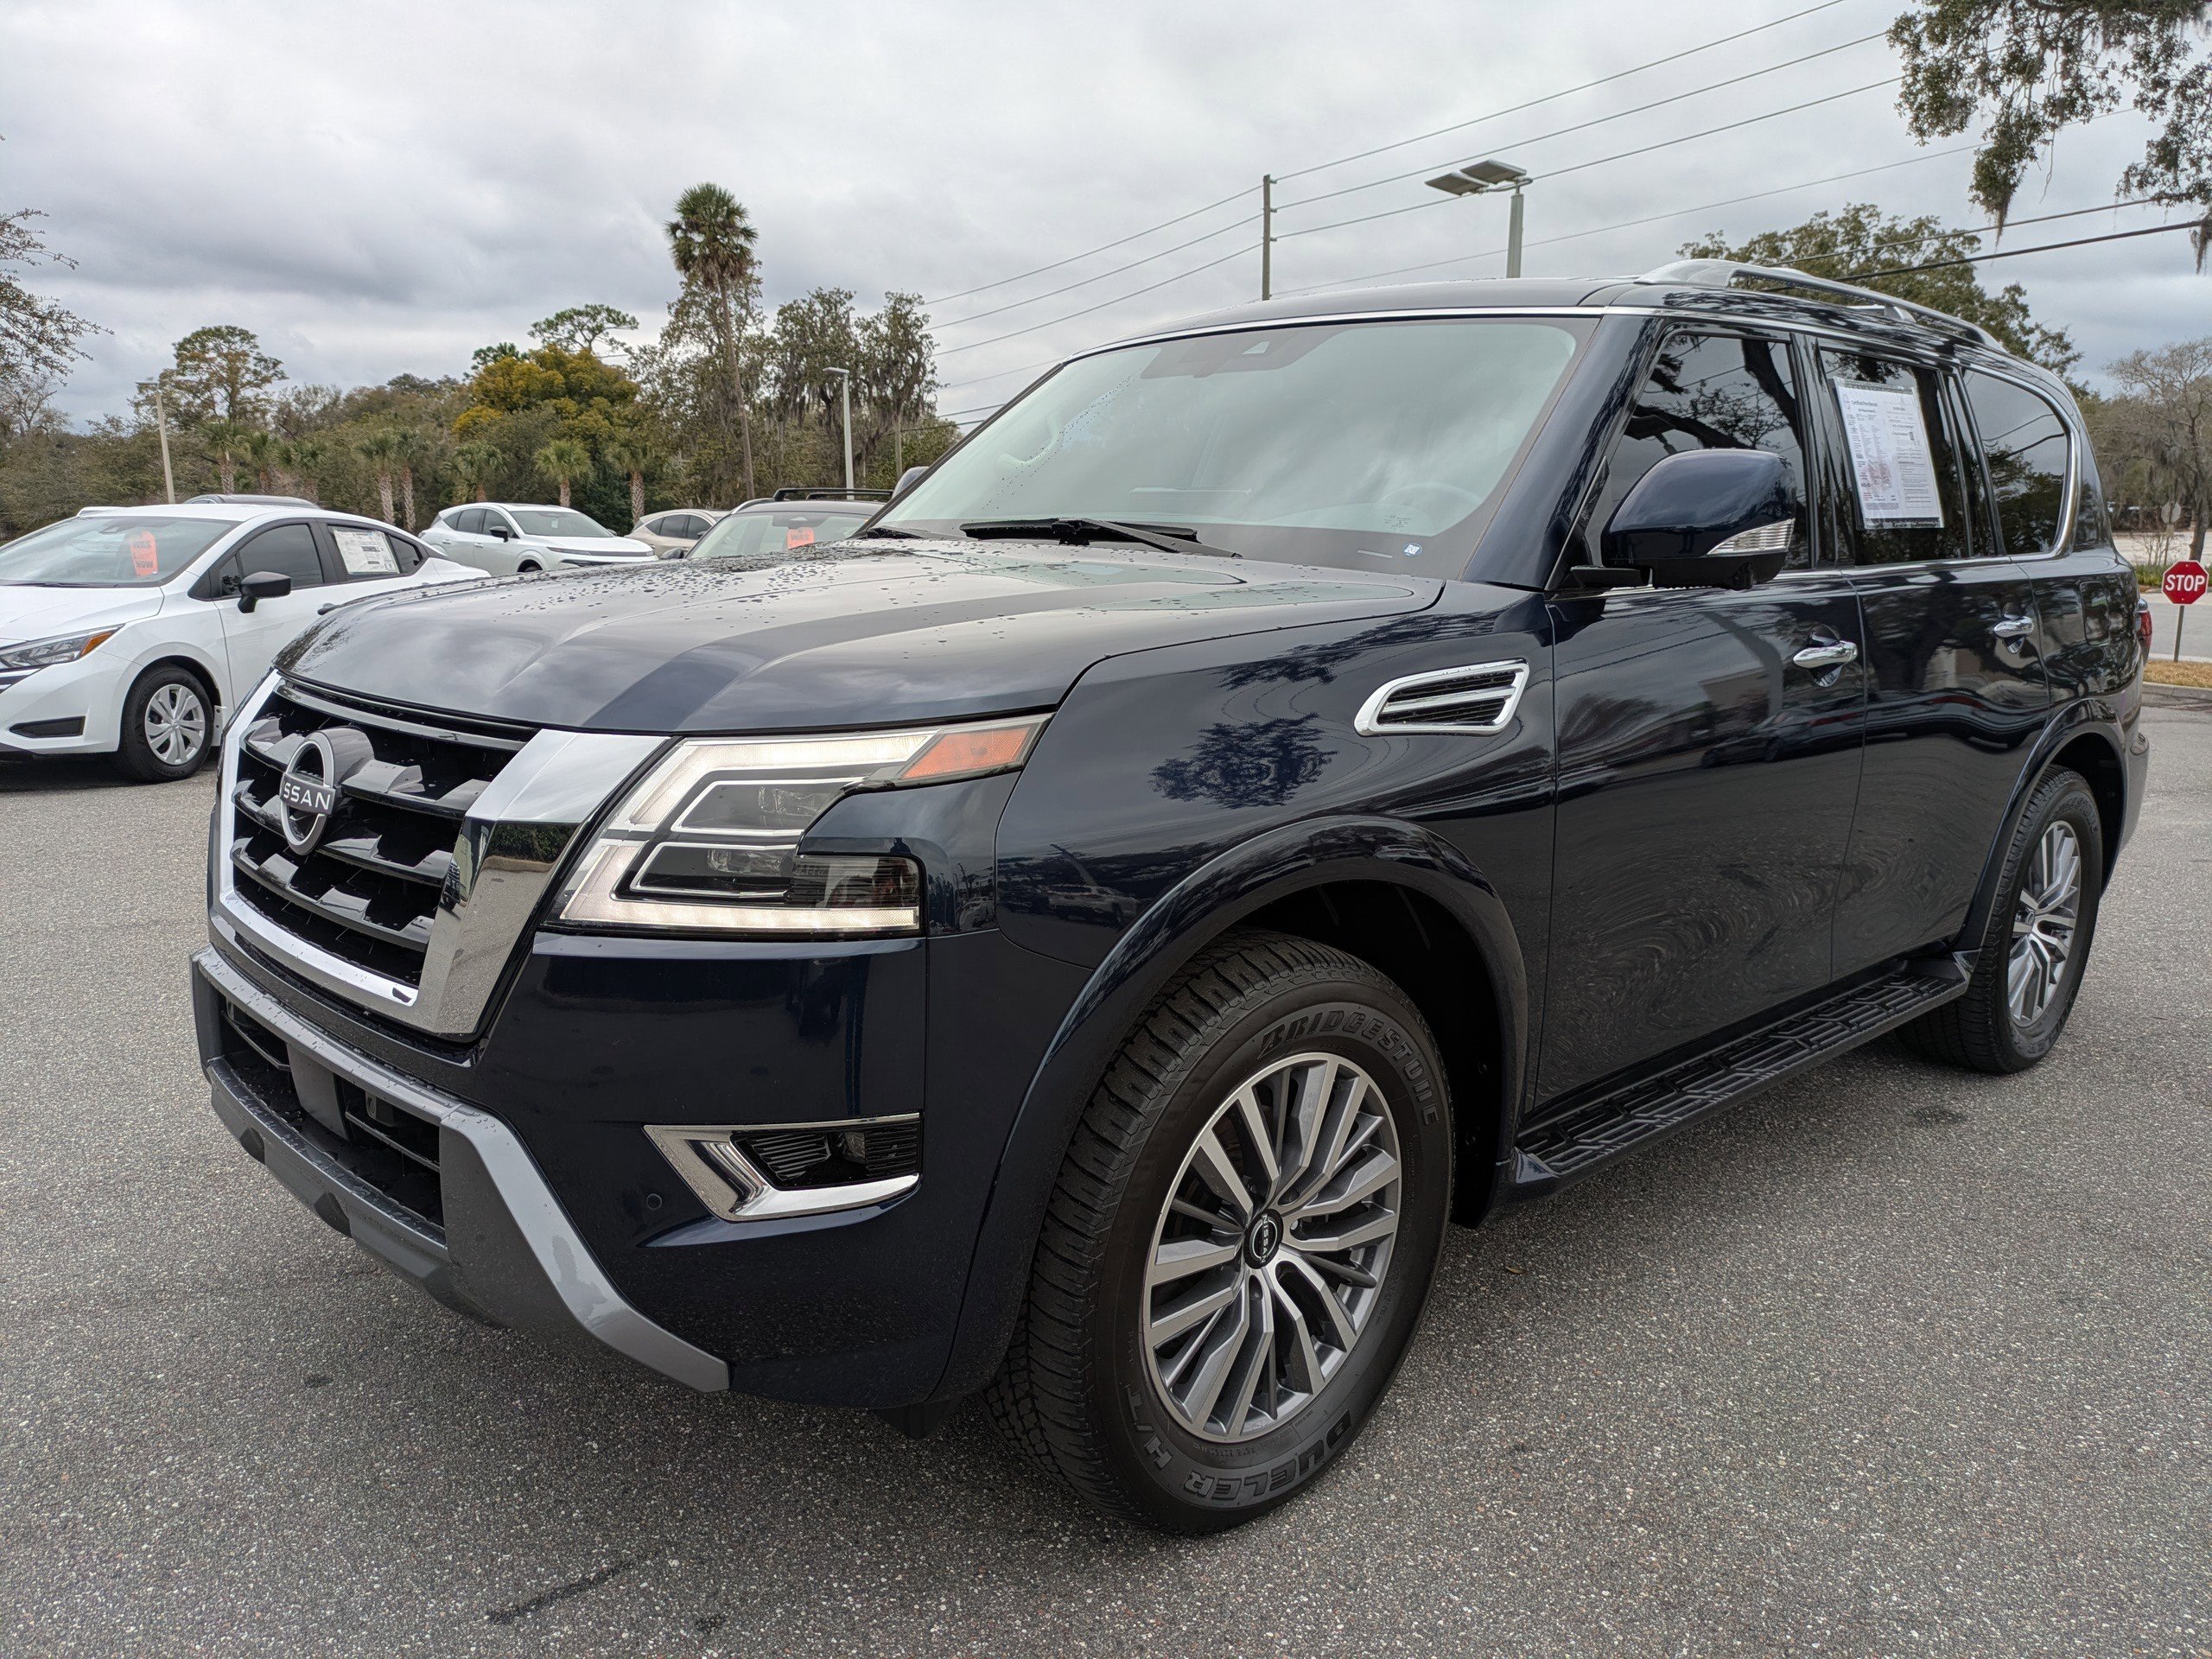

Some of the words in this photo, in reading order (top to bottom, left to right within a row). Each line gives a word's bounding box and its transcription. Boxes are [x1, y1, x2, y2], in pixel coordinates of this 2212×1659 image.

[135, 560, 154, 569] NOW
[2165, 574, 2205, 592] STOP
[283, 781, 331, 810] SSAN
[1258, 1009, 1440, 1126] BRIDGESTONE
[1184, 1408, 1352, 1501] DUELER
